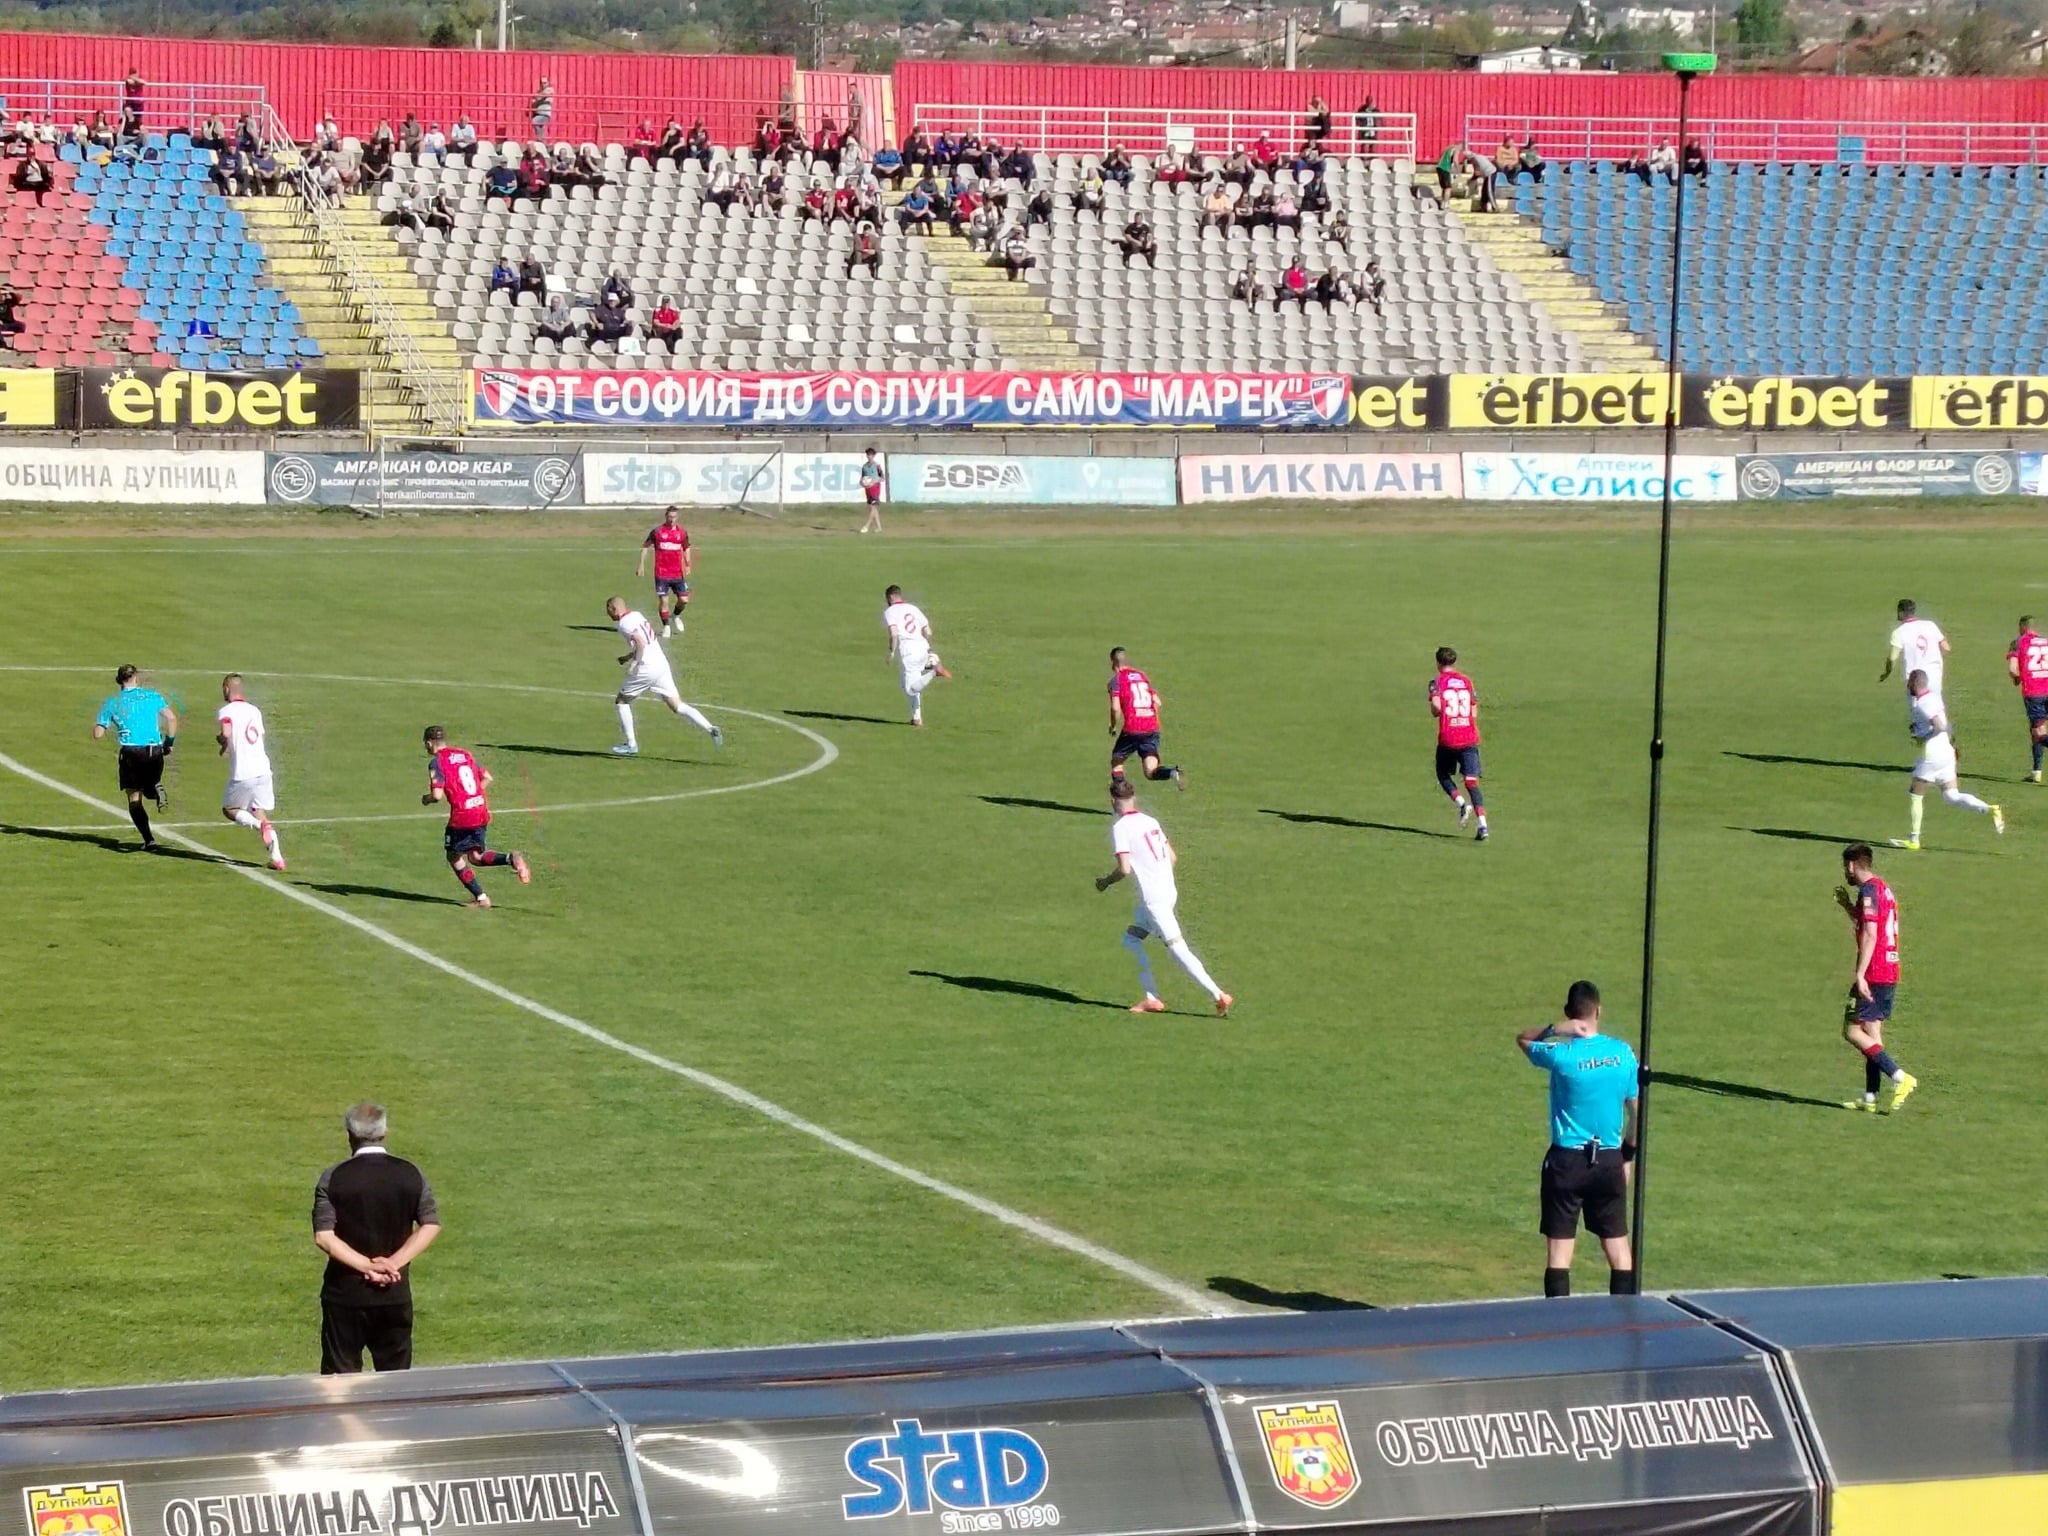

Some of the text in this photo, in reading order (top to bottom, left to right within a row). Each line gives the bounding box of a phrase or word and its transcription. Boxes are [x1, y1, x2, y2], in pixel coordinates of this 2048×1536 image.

[108, 371, 317, 425] efbet
[528, 376, 582, 416] ОТ
[593, 376, 741, 418] СОФИЯ
[753, 378, 812, 420] ДО
[826, 377, 965, 416] СОЛУН
[1006, 377, 1123, 416] САМО
[1134, 377, 1303, 417] "МАРЕК"
[1348, 377, 1427, 427] et
[1482, 377, 1655, 425] efbet
[1708, 378, 1889, 427] efbet
[5, 463, 239, 492] ОБЩИНА ДУПНИЦА
[333, 460, 513, 474] АМЕРИКАН ФЛОР КЕАР
[924, 464, 1026, 488] ЗОРА
[1201, 463, 1443, 494] НИКМАН
[1510, 458, 1695, 497] Хелиос
[1577, 457, 1653, 472] Аптеки
[1795, 459, 1955, 474] АМЕРИКАН ФЛОР КЕАР
[1443, 689, 1471, 717] 33
[245, 719, 258, 744] 6
[1143, 829, 1166, 861] 17
[1267, 1415, 1335, 1428] ДУПНИЦА
[1377, 1395, 1773, 1468] ОБЩИНА ДУПНИЦА
[37, 1496, 116, 1511] ДУПНИЦА
[163, 1471, 620, 1536] ОБЩИНА ДУПНИЦА
[940, 1506, 1060, 1533] Since 1990
